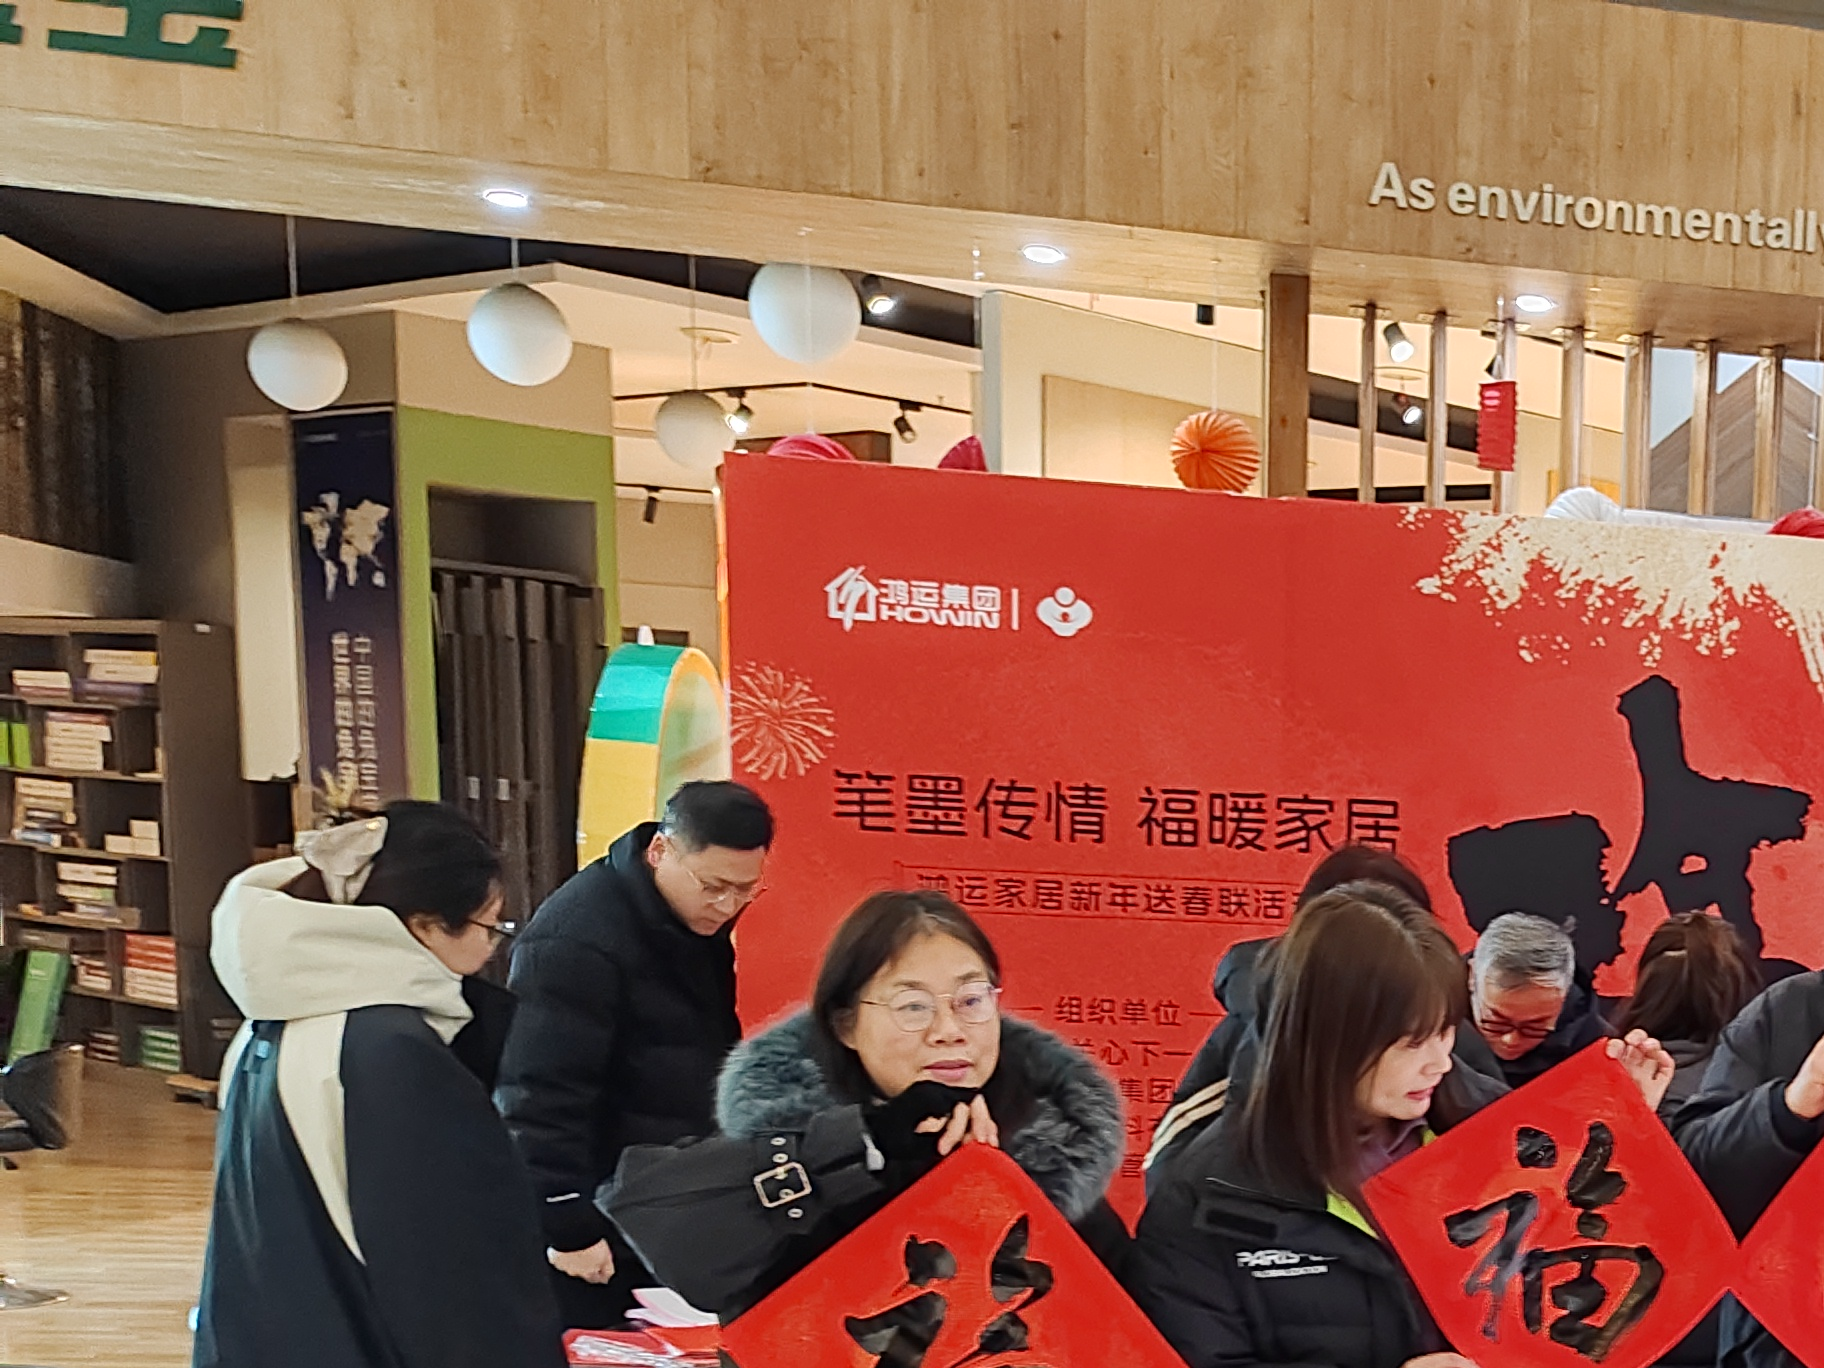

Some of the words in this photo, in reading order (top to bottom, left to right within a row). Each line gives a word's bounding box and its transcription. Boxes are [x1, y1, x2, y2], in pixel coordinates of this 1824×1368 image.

[1369, 161, 1436, 210] As
[879, 578, 1001, 611] 鸿运集团
[879, 604, 1000, 629] HOWIN
[832, 769, 1108, 843] 笔墨传情
[1138, 785, 1401, 854] 福暖家居
[916, 874, 1300, 919] 运家居新年送春联活
[1055, 996, 1182, 1026] 组织单位
[1444, 1121, 1665, 1363] 福
